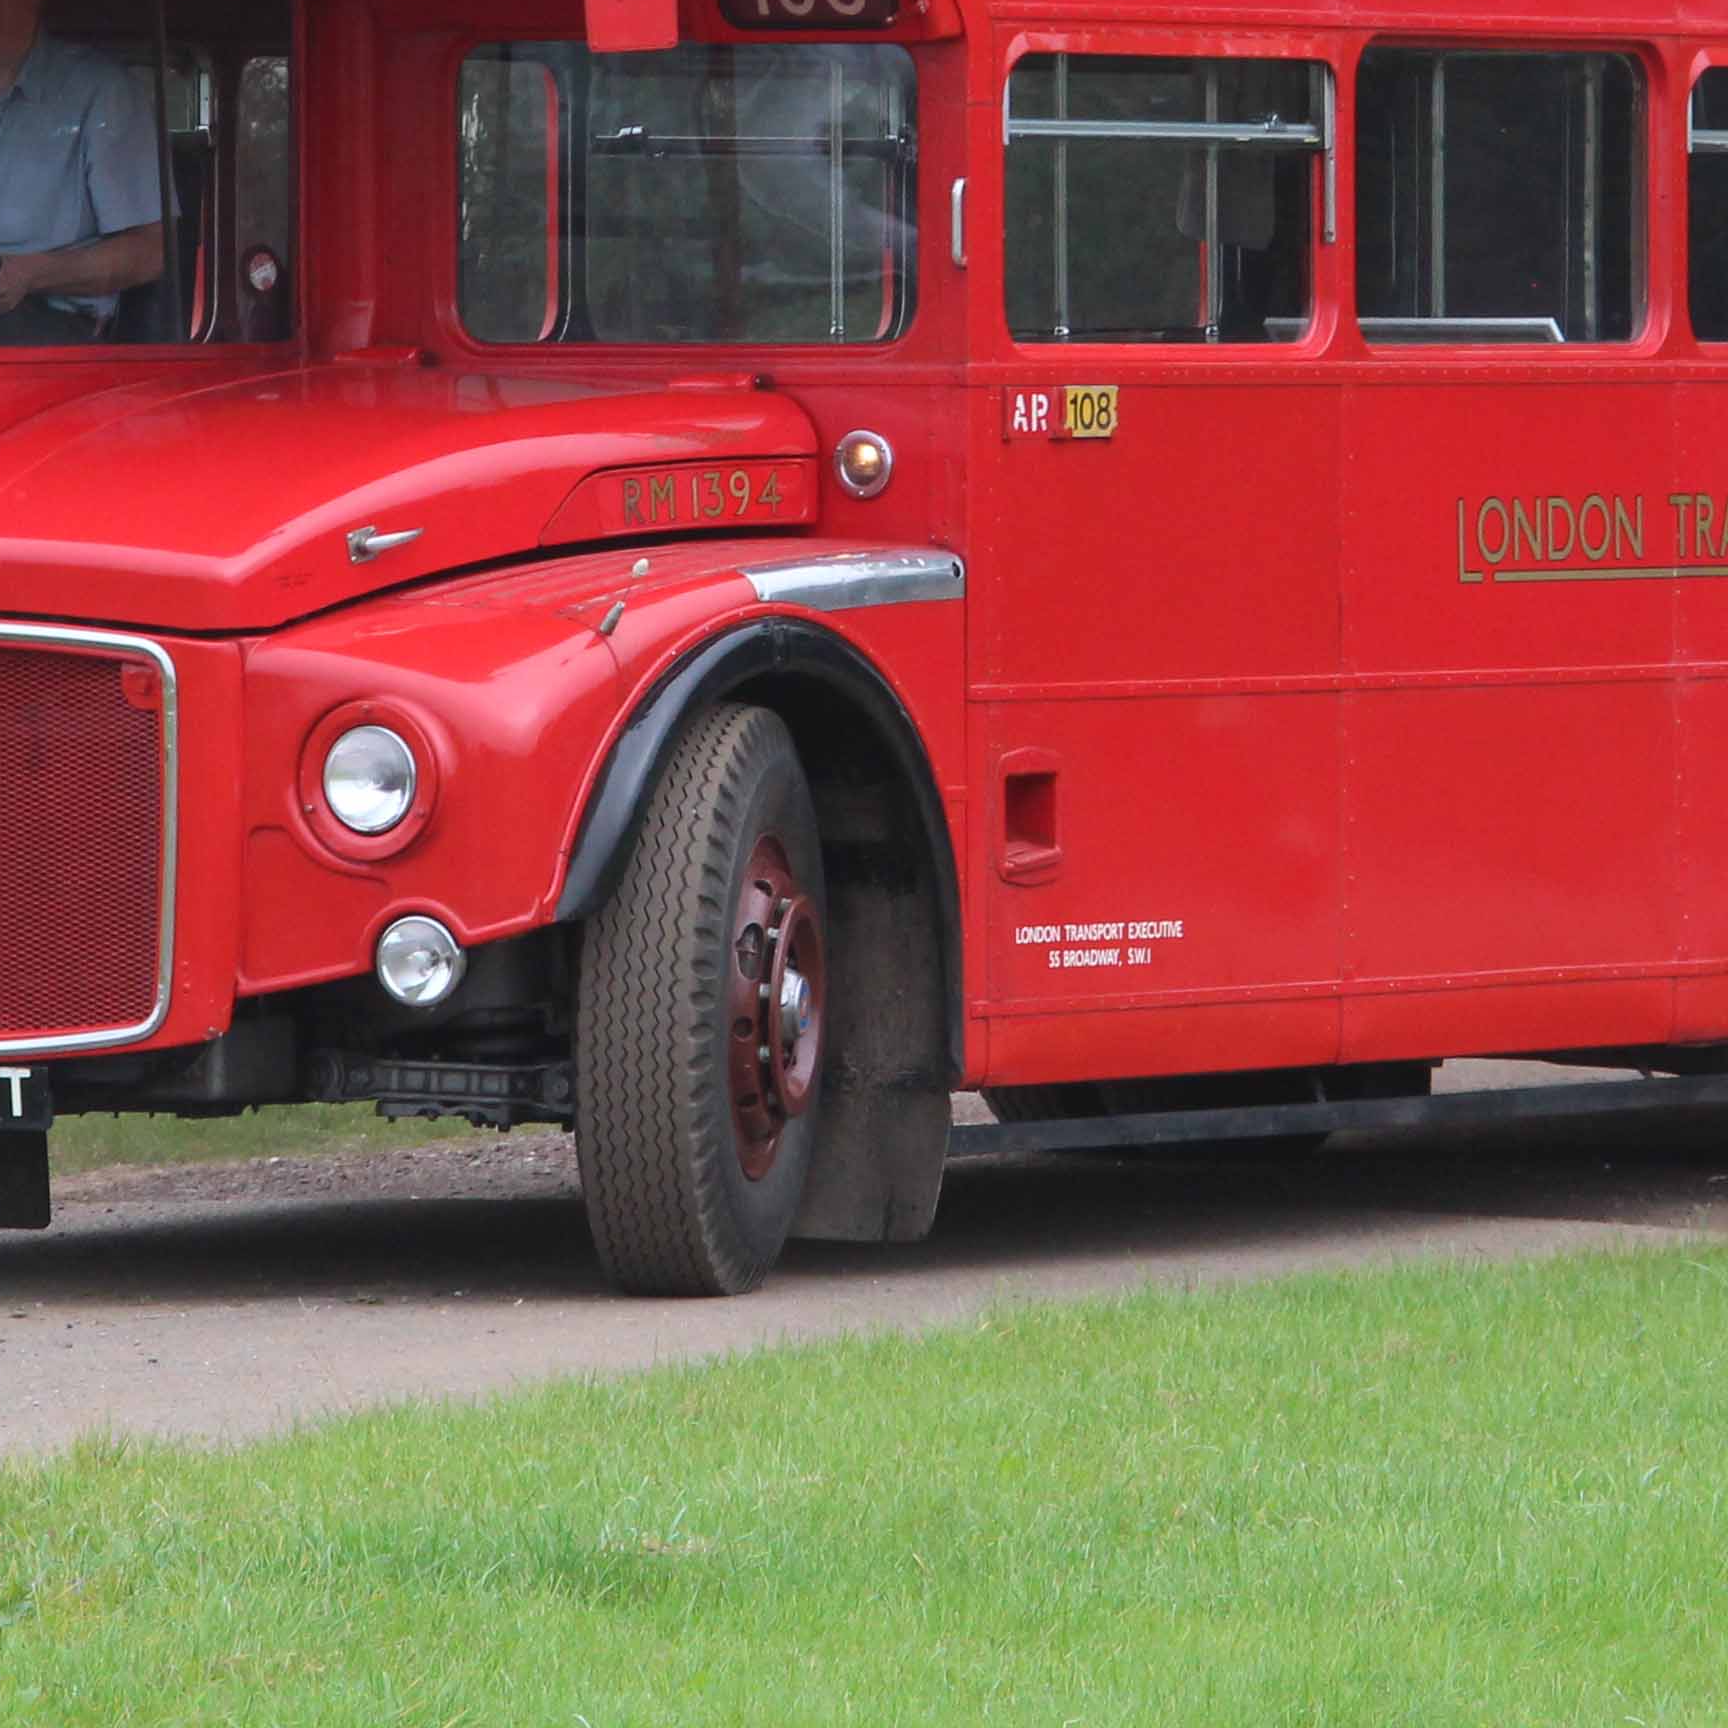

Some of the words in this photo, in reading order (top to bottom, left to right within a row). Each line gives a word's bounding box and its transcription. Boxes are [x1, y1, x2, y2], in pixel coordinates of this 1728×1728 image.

[1013, 394, 1048, 432] AR
[1070, 392, 1111, 430] 108
[624, 475, 676, 525] RM
[692, 470, 782, 519] 1394
[1458, 494, 1643, 583] LONDON
[1016, 925, 1060, 944] LONDON
[1065, 923, 1124, 942] TRANSPORT
[1128, 920, 1183, 939] EXECUTIVE
[1063, 948, 1122, 968] BROADWAY,
